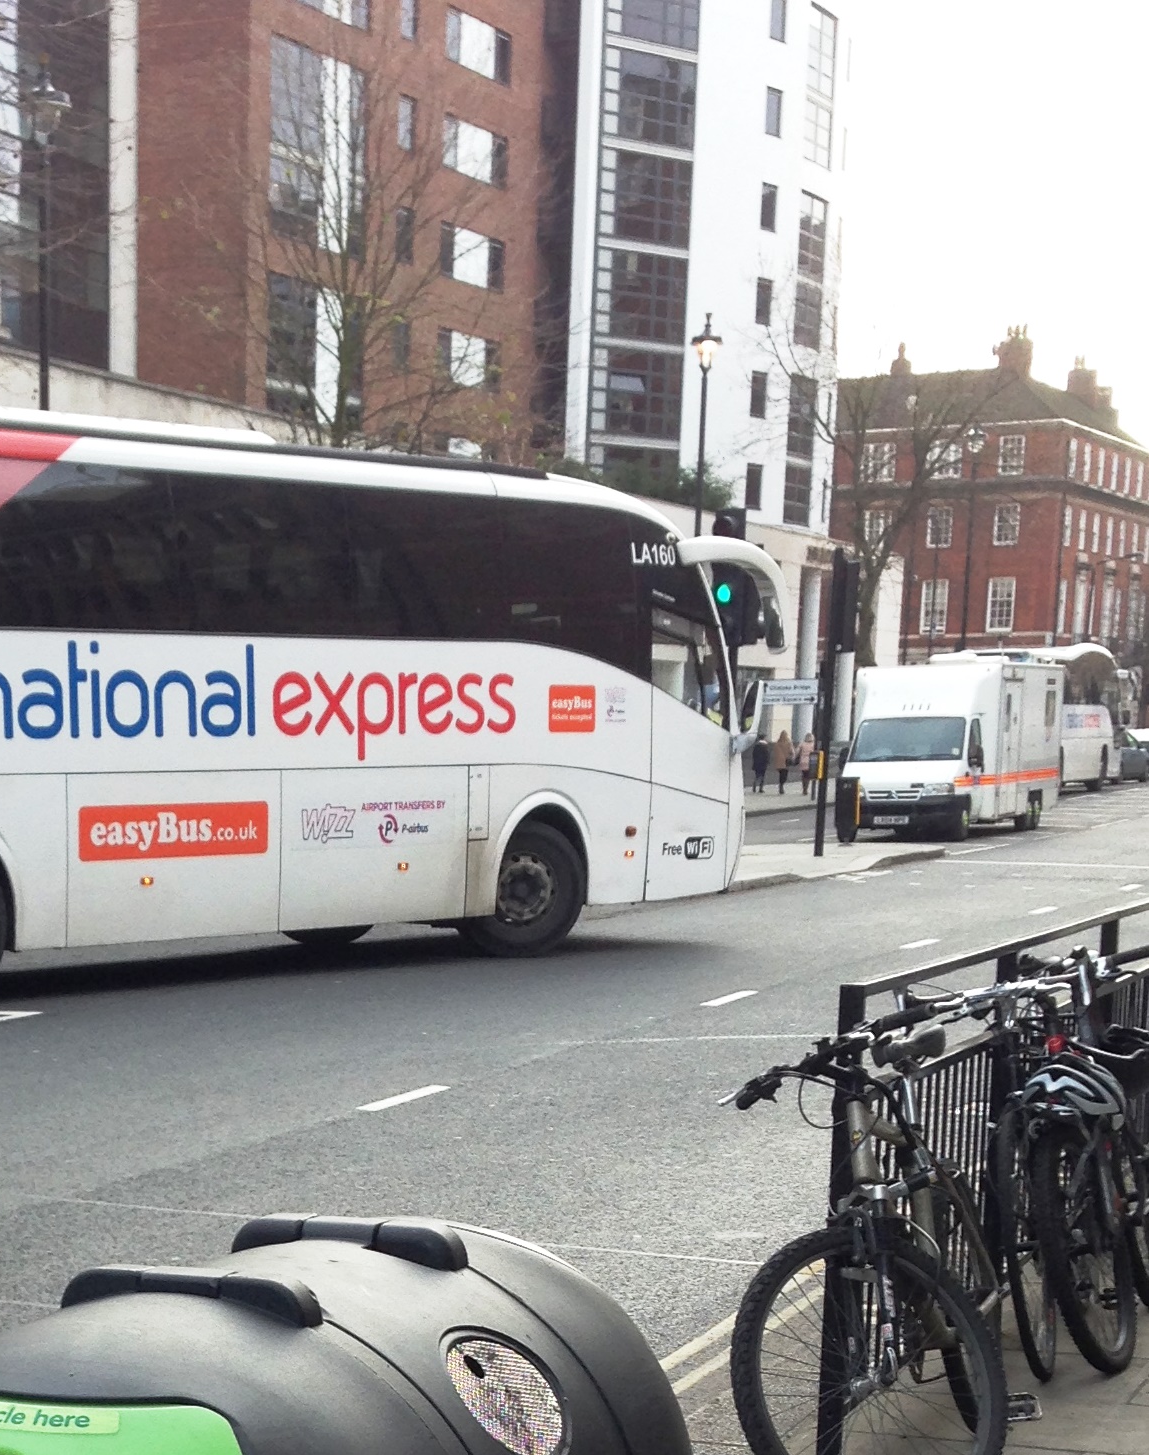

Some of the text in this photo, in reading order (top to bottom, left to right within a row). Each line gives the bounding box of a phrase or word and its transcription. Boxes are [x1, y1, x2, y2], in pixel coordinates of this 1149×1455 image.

[631, 542, 676, 566] LA160
[552, 696, 592, 711] easyBus
[272, 671, 517, 761] express
[361, 799, 446, 812] AIRPORT TRANSFERS BY
[89, 811, 258, 852] easyBus.co.uk
[662, 842, 682, 856] Free
[33, 1409, 90, 1428] here
